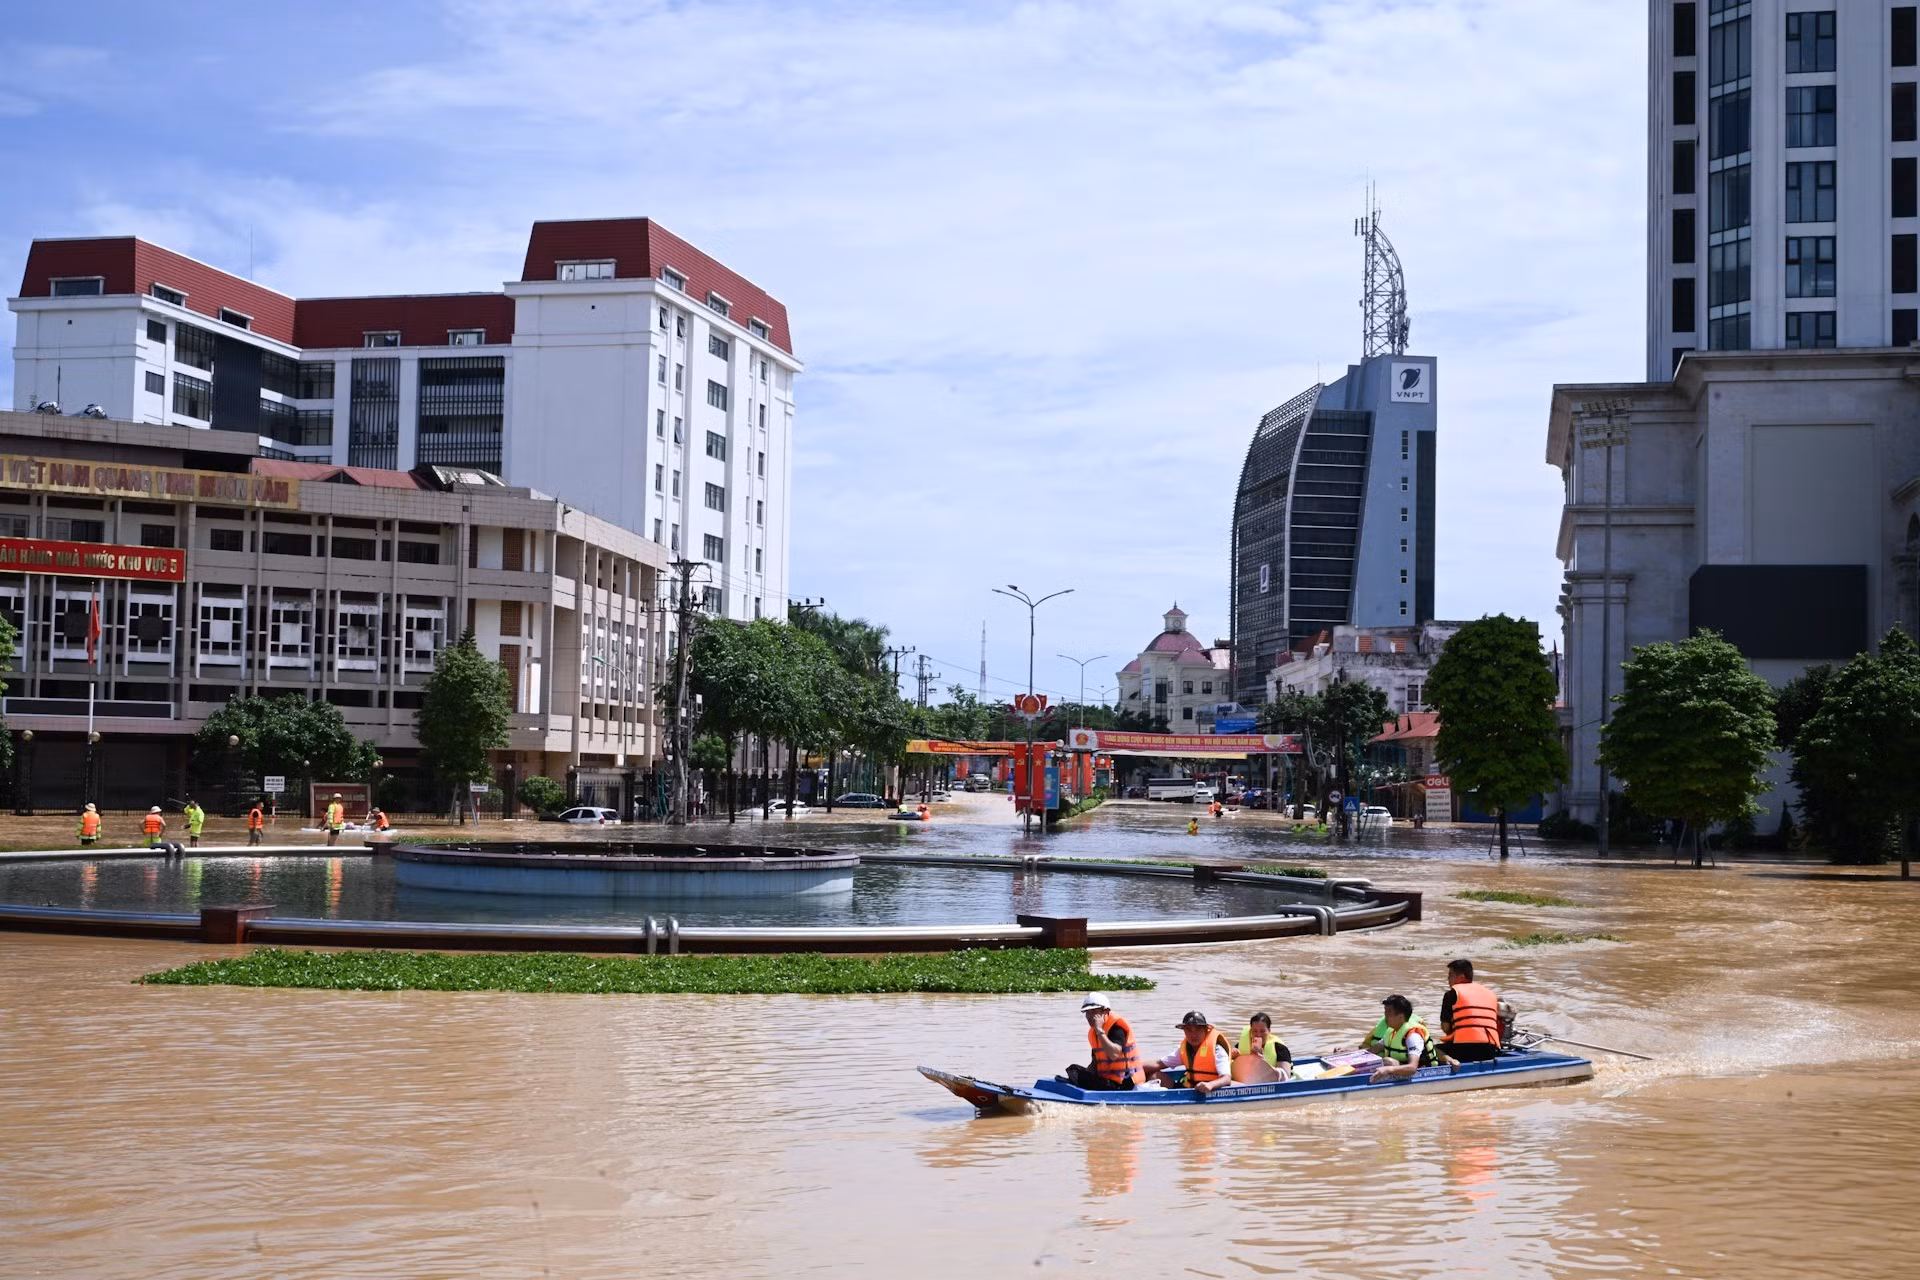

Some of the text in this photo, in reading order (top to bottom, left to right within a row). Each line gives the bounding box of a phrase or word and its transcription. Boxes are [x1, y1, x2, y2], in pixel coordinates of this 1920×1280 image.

[9, 456, 46, 488] VIỆT
[50, 462, 90, 487] NAM
[95, 466, 152, 492] QUANG
[156, 471, 195, 497] VINH
[199, 473, 248, 500] MUÔN
[252, 476, 289, 503] NĂM
[20, 546, 53, 565] HÀNG
[56, 548, 80, 567] NHÀ
[84, 550, 115, 569] NƯỚC
[118, 555, 141, 571] KHU
[145, 557, 167, 575] VỰC
[170, 559, 177, 573] 5
